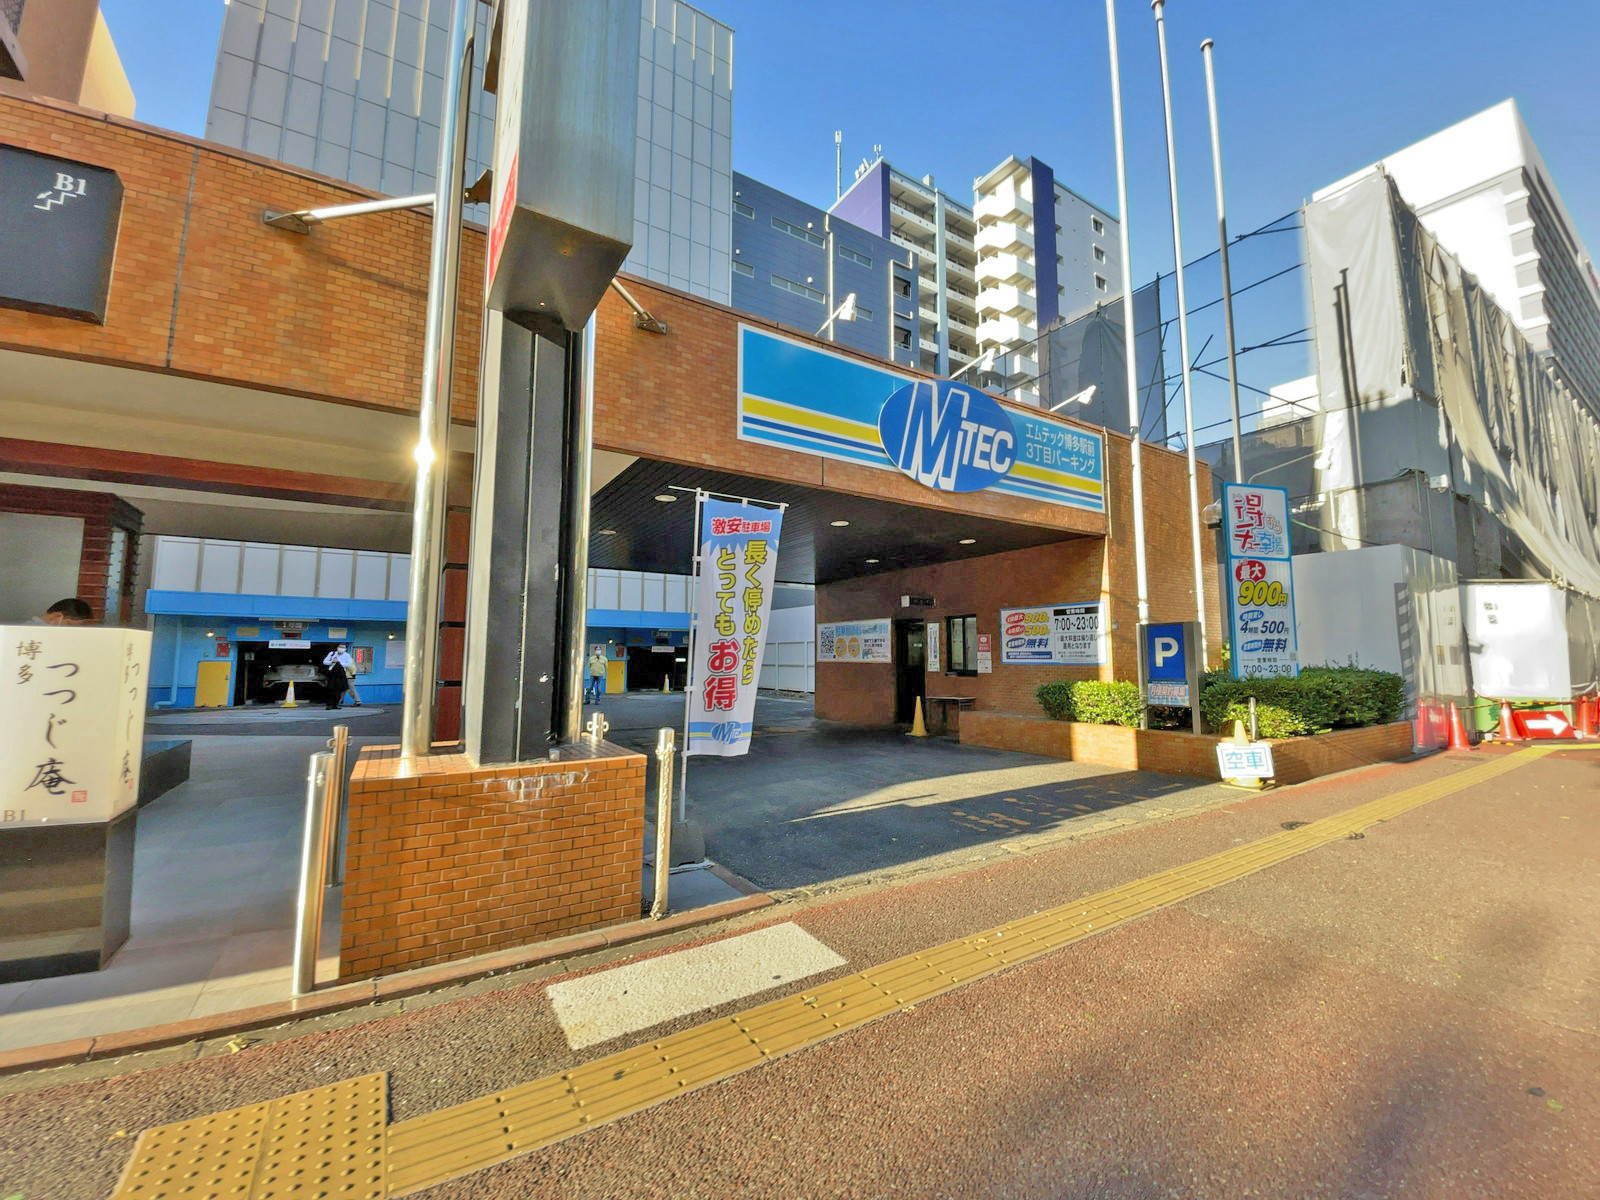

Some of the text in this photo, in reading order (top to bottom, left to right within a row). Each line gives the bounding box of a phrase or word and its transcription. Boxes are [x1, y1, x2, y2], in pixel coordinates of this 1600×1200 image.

[53, 172, 87, 196] B1
[898, 379, 1014, 491] MTEC
[1025, 423, 1095, 457] エムテック博多駅前
[1026, 442, 1096, 474] 3丁目パーキング
[711, 517, 772, 535] 激安駐車場
[1237, 580, 1288, 607] 900円
[740, 539, 768, 686] 長く停めたら
[1260, 620, 1290, 634] 500円
[1154, 636, 1179, 667] P
[1262, 638, 1287, 653] 無料
[16, 640, 43, 685] 博多
[24, 662, 80, 795] つつじ庵
[1225, 750, 1265, 770] 空車
